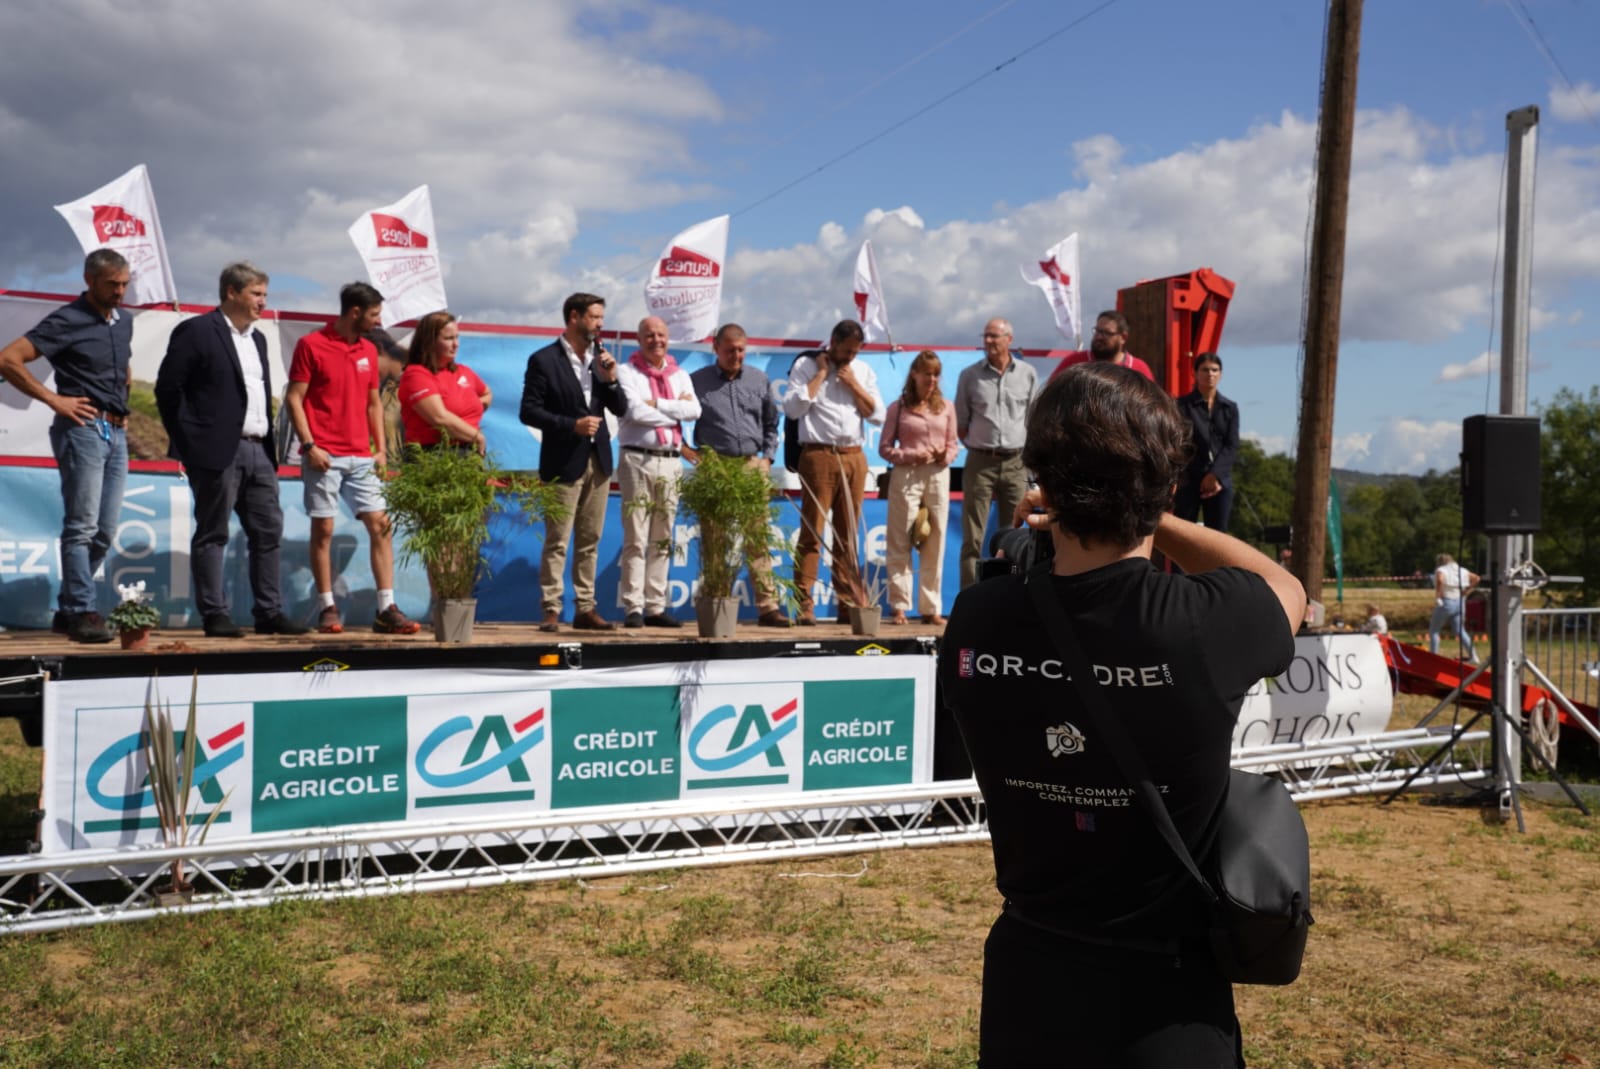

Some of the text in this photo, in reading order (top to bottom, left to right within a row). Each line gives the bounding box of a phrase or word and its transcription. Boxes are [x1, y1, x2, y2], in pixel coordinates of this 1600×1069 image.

[976, 653, 1164, 687] QR-CDRE
[573, 728, 658, 751] CRÉDIT
[822, 718, 895, 739] CRÉDIT
[279, 744, 381, 769] CRÉDIT
[808, 745, 908, 767] AGRICOLE
[557, 757, 675, 781] AGRICOLE
[259, 773, 400, 801] AGRICOLE
[1004, 777, 1170, 797] IMPORTEZ, COMMANZ
[1038, 791, 1131, 807] CONTEMPLEZ
